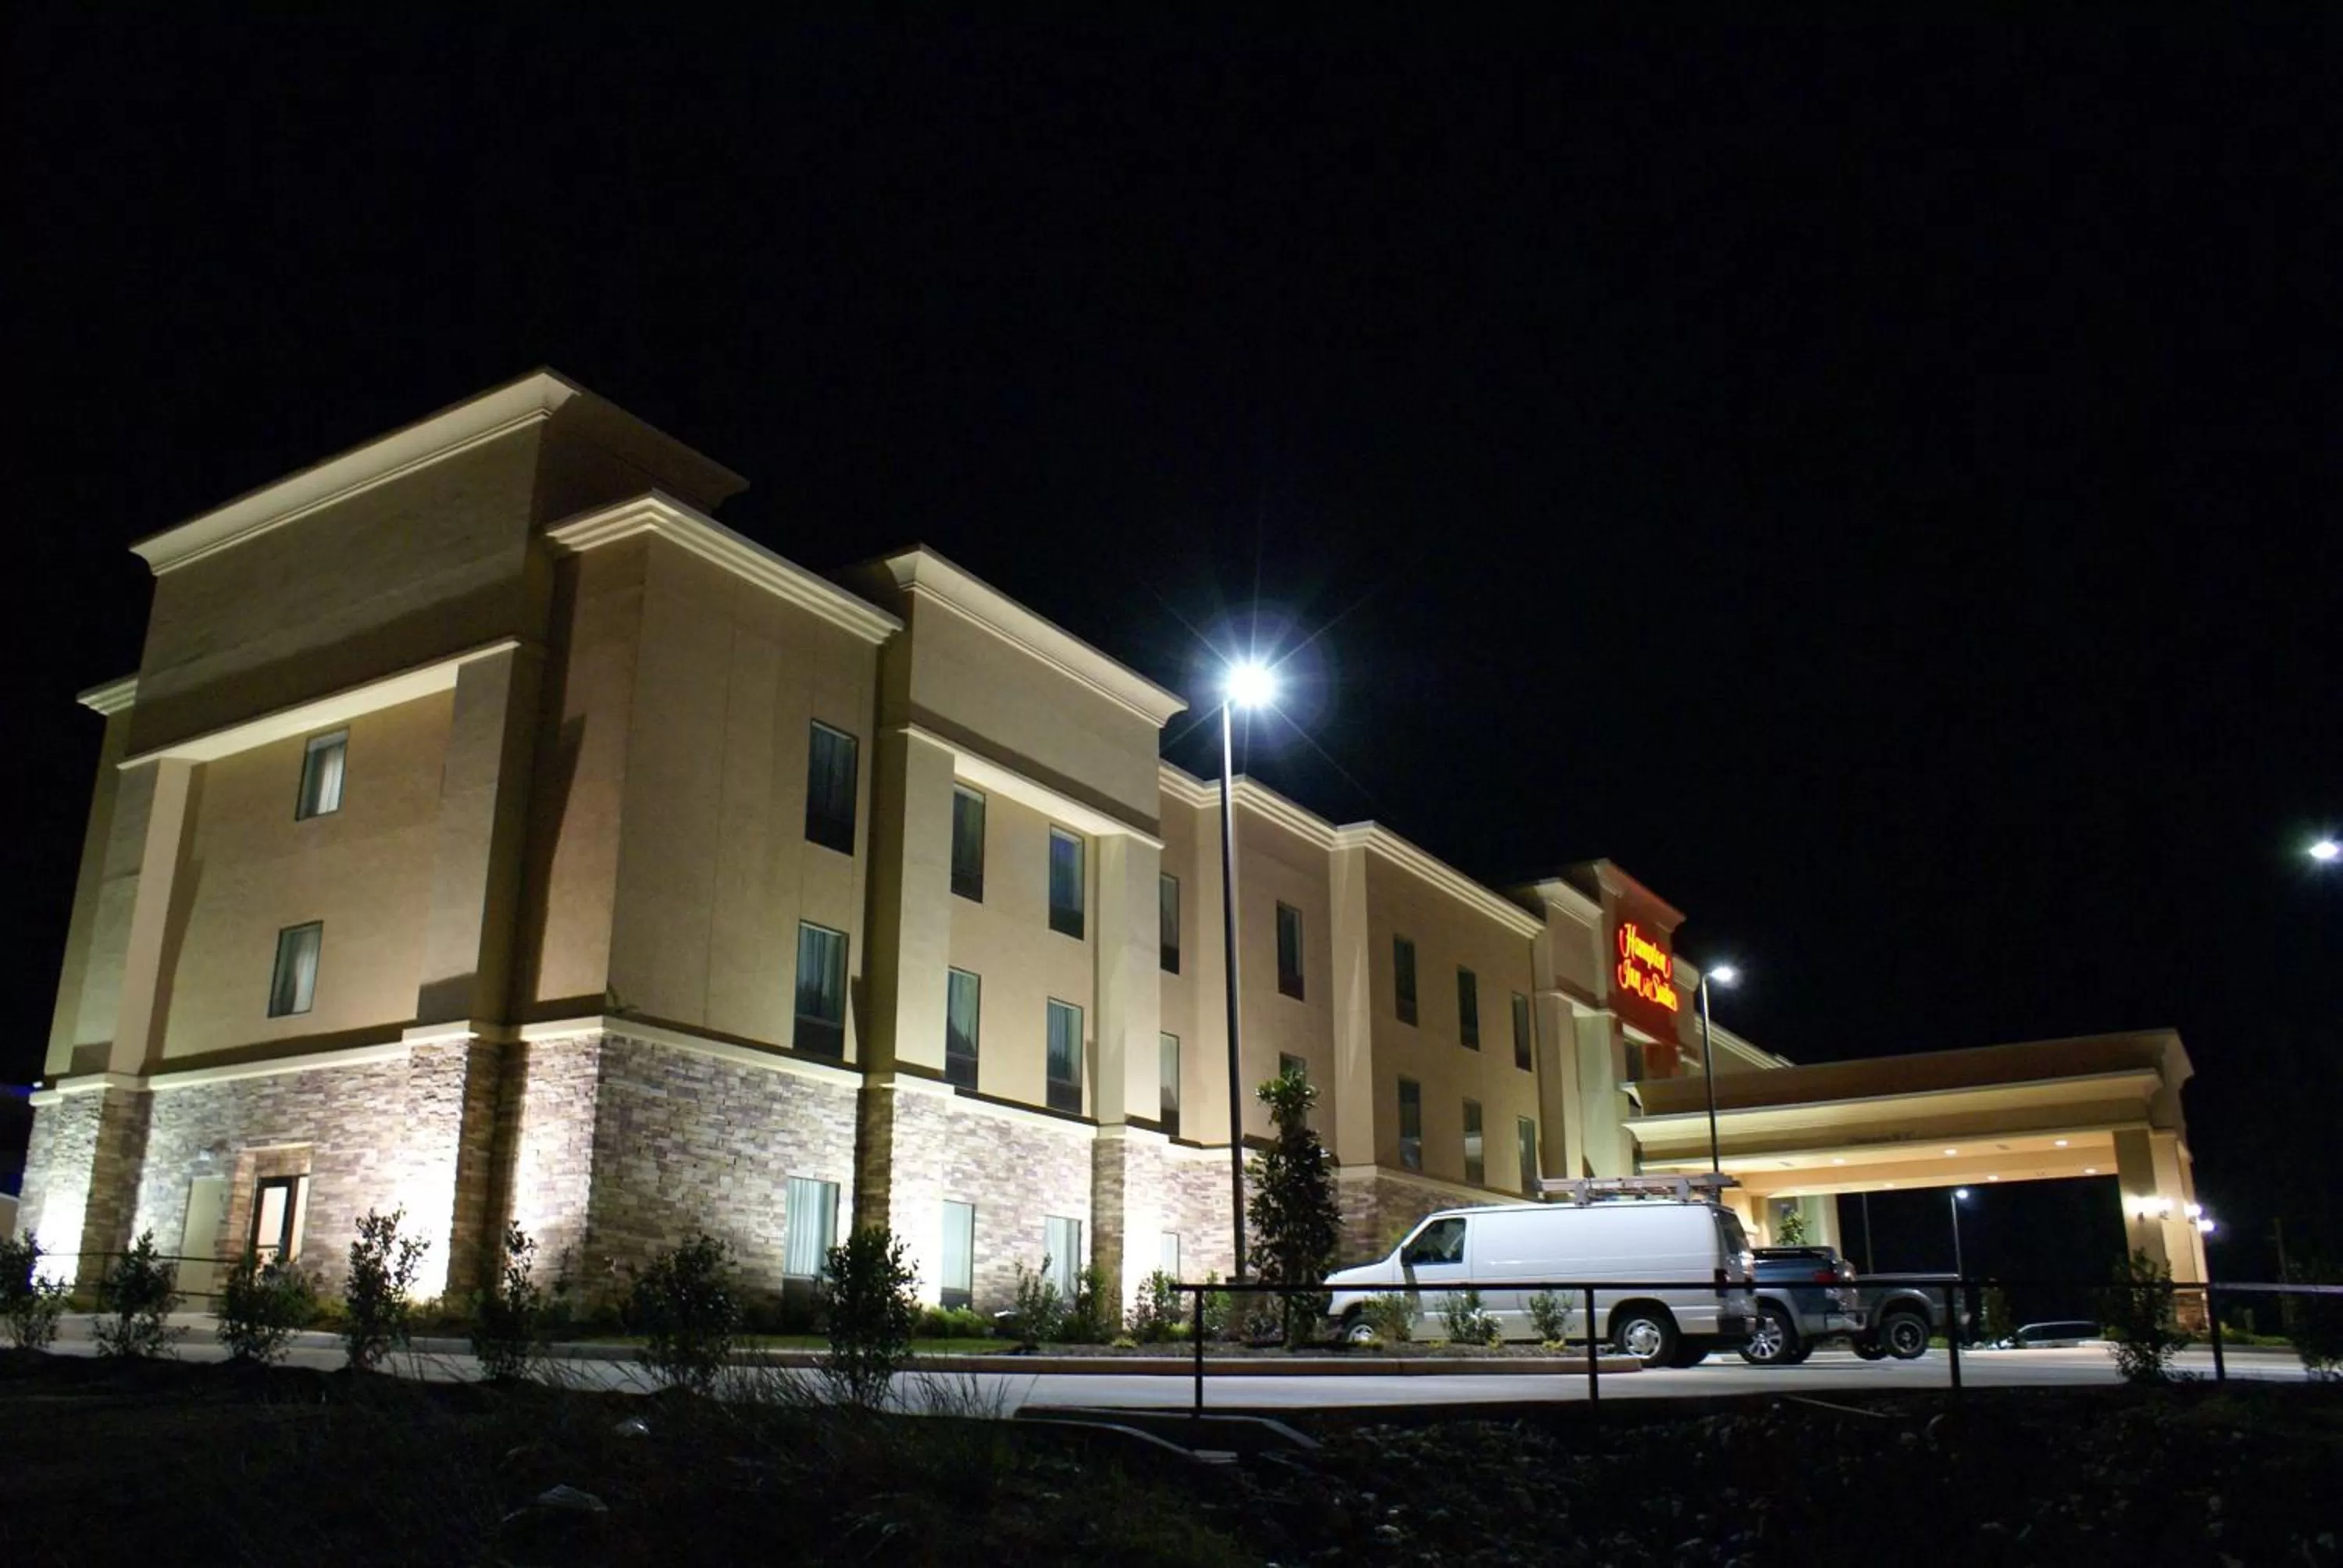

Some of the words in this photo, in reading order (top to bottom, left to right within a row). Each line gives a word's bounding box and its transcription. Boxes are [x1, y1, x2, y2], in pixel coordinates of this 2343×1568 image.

[1619, 923, 1671, 978] Hampton
[1617, 959, 1645, 997] Inn
[1649, 973, 1678, 1012] Suites
